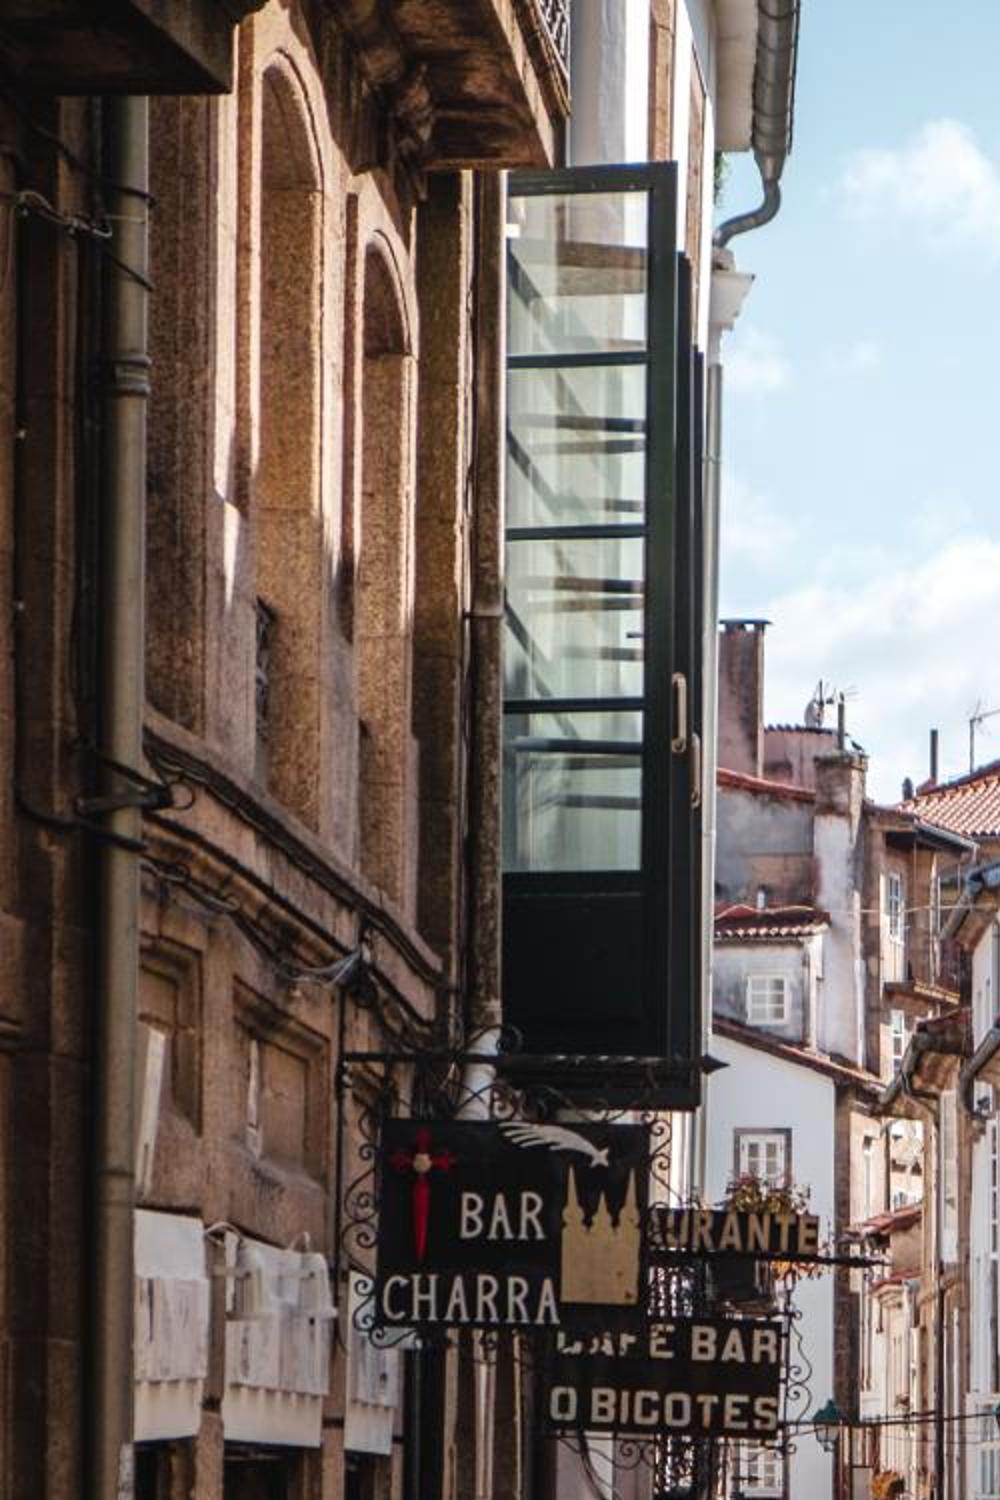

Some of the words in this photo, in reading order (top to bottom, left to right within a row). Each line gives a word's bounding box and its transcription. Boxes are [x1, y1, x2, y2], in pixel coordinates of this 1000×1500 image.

[460, 1192, 545, 1240] BAR
[383, 1274, 560, 1325] CHARRA
[691, 1326, 777, 1363] BAR
[549, 1386, 578, 1422] O
